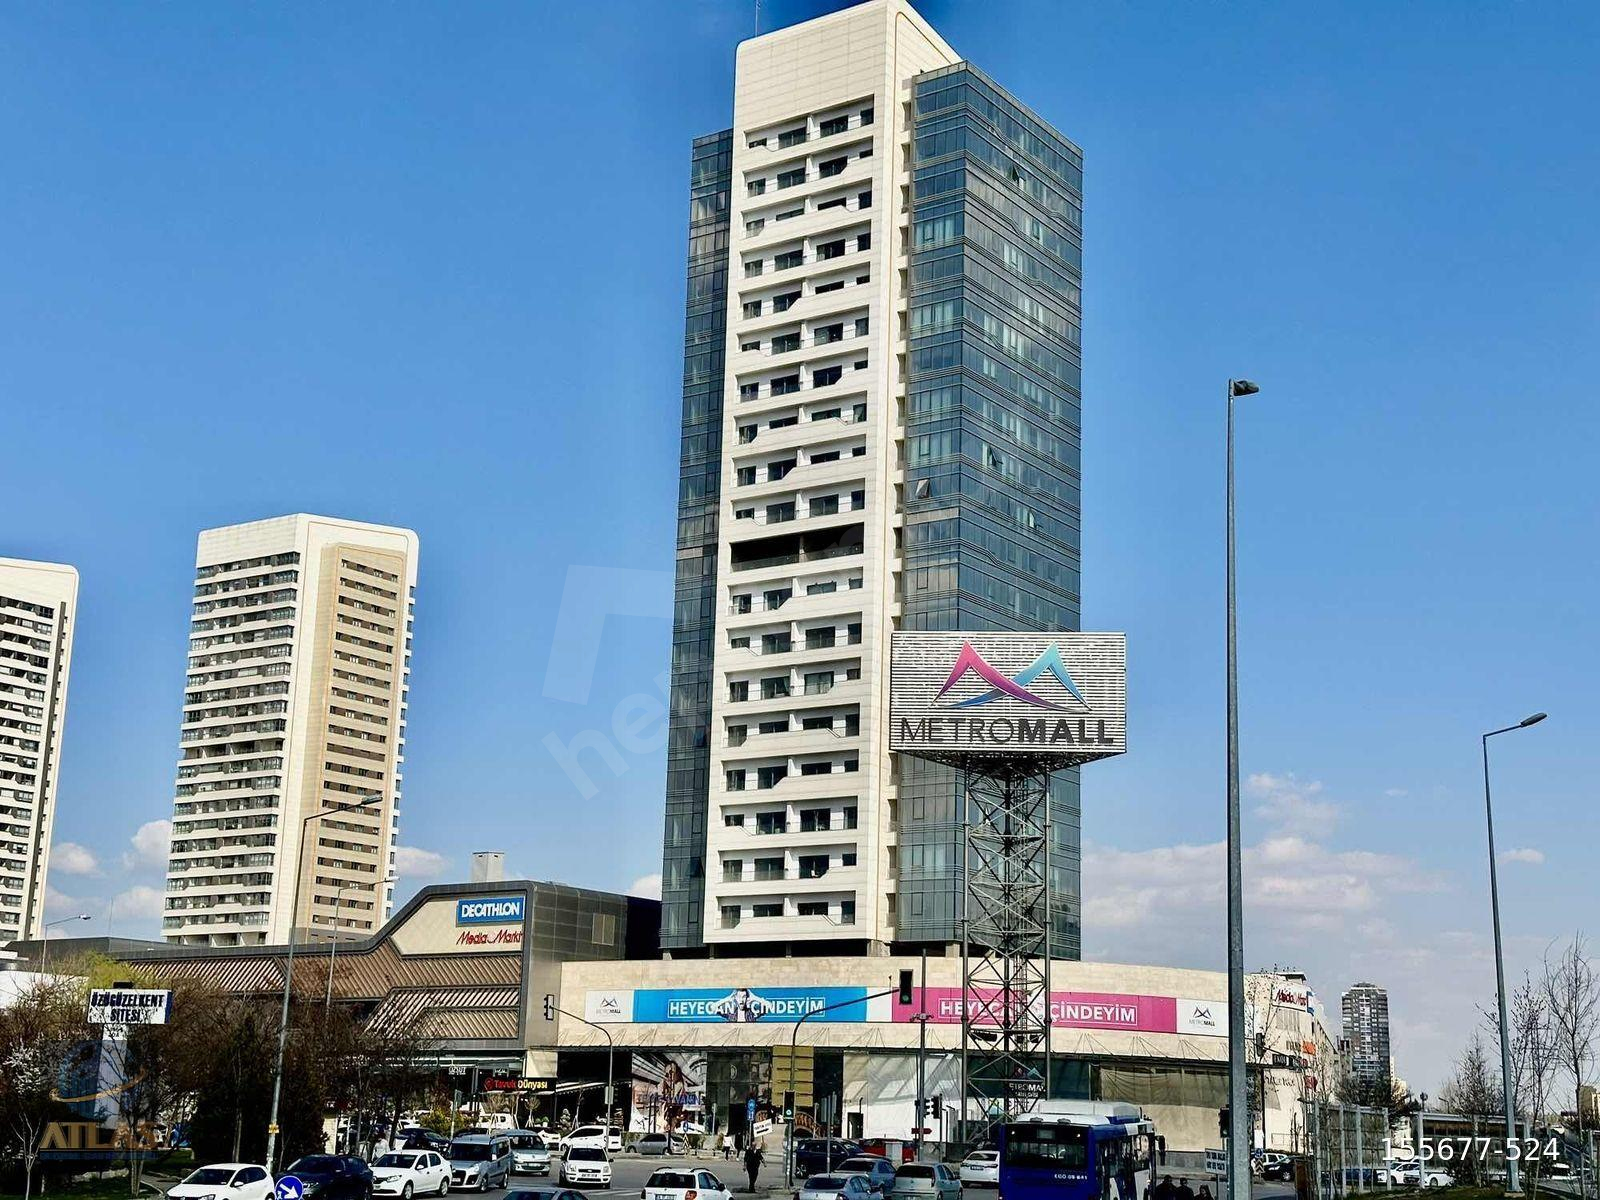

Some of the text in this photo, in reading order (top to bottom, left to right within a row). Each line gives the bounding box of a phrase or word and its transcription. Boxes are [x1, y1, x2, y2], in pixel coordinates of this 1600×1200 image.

[900, 717, 1114, 744] METROMALL
[461, 902, 521, 918] DECATHLON
[456, 931, 488, 945] Media
[940, 1000, 1014, 1019] HEYECA
